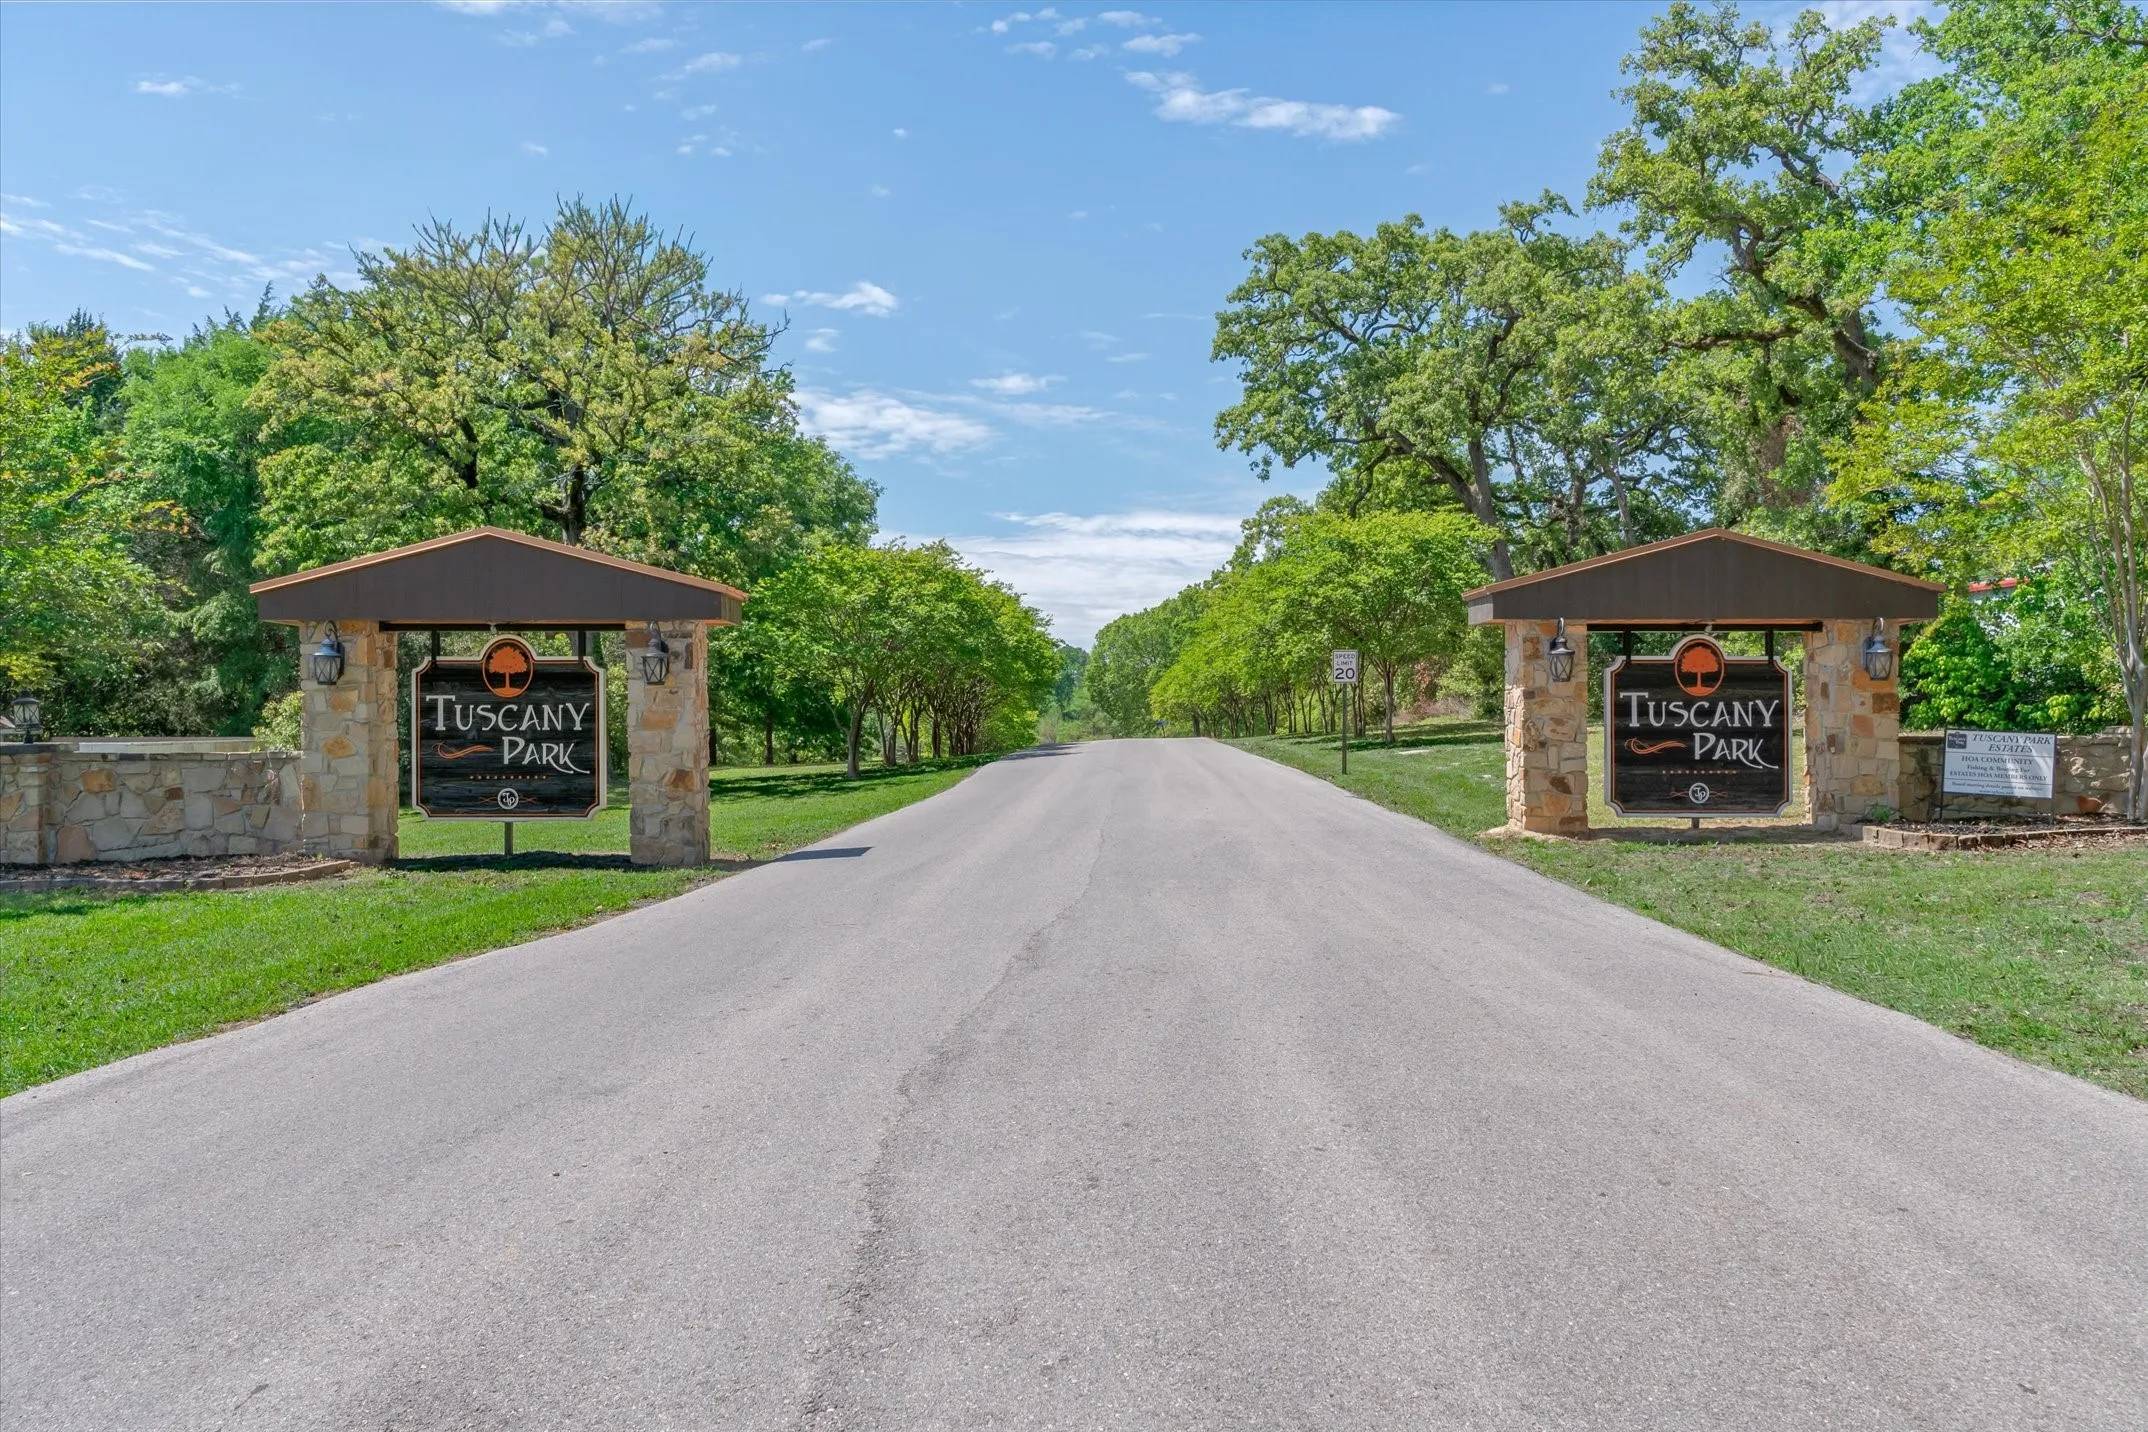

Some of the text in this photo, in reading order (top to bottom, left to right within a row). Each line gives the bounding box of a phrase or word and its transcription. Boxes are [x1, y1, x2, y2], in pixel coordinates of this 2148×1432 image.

[1335, 667, 1355, 680] 20
[426, 694, 590, 732] TUSCANY
[1619, 691, 1780, 728] TUSCANY
[1972, 734, 2021, 744] TUSCANY
[2023, 736, 2051, 745] PARK
[502, 735, 591, 775] PARK
[1692, 732, 1779, 770] PARK
[1988, 743, 2033, 754] ESTATES
[1961, 755, 2033, 766] HOA COMMUNITY
[1994, 772, 2028, 781] MEMBERS
